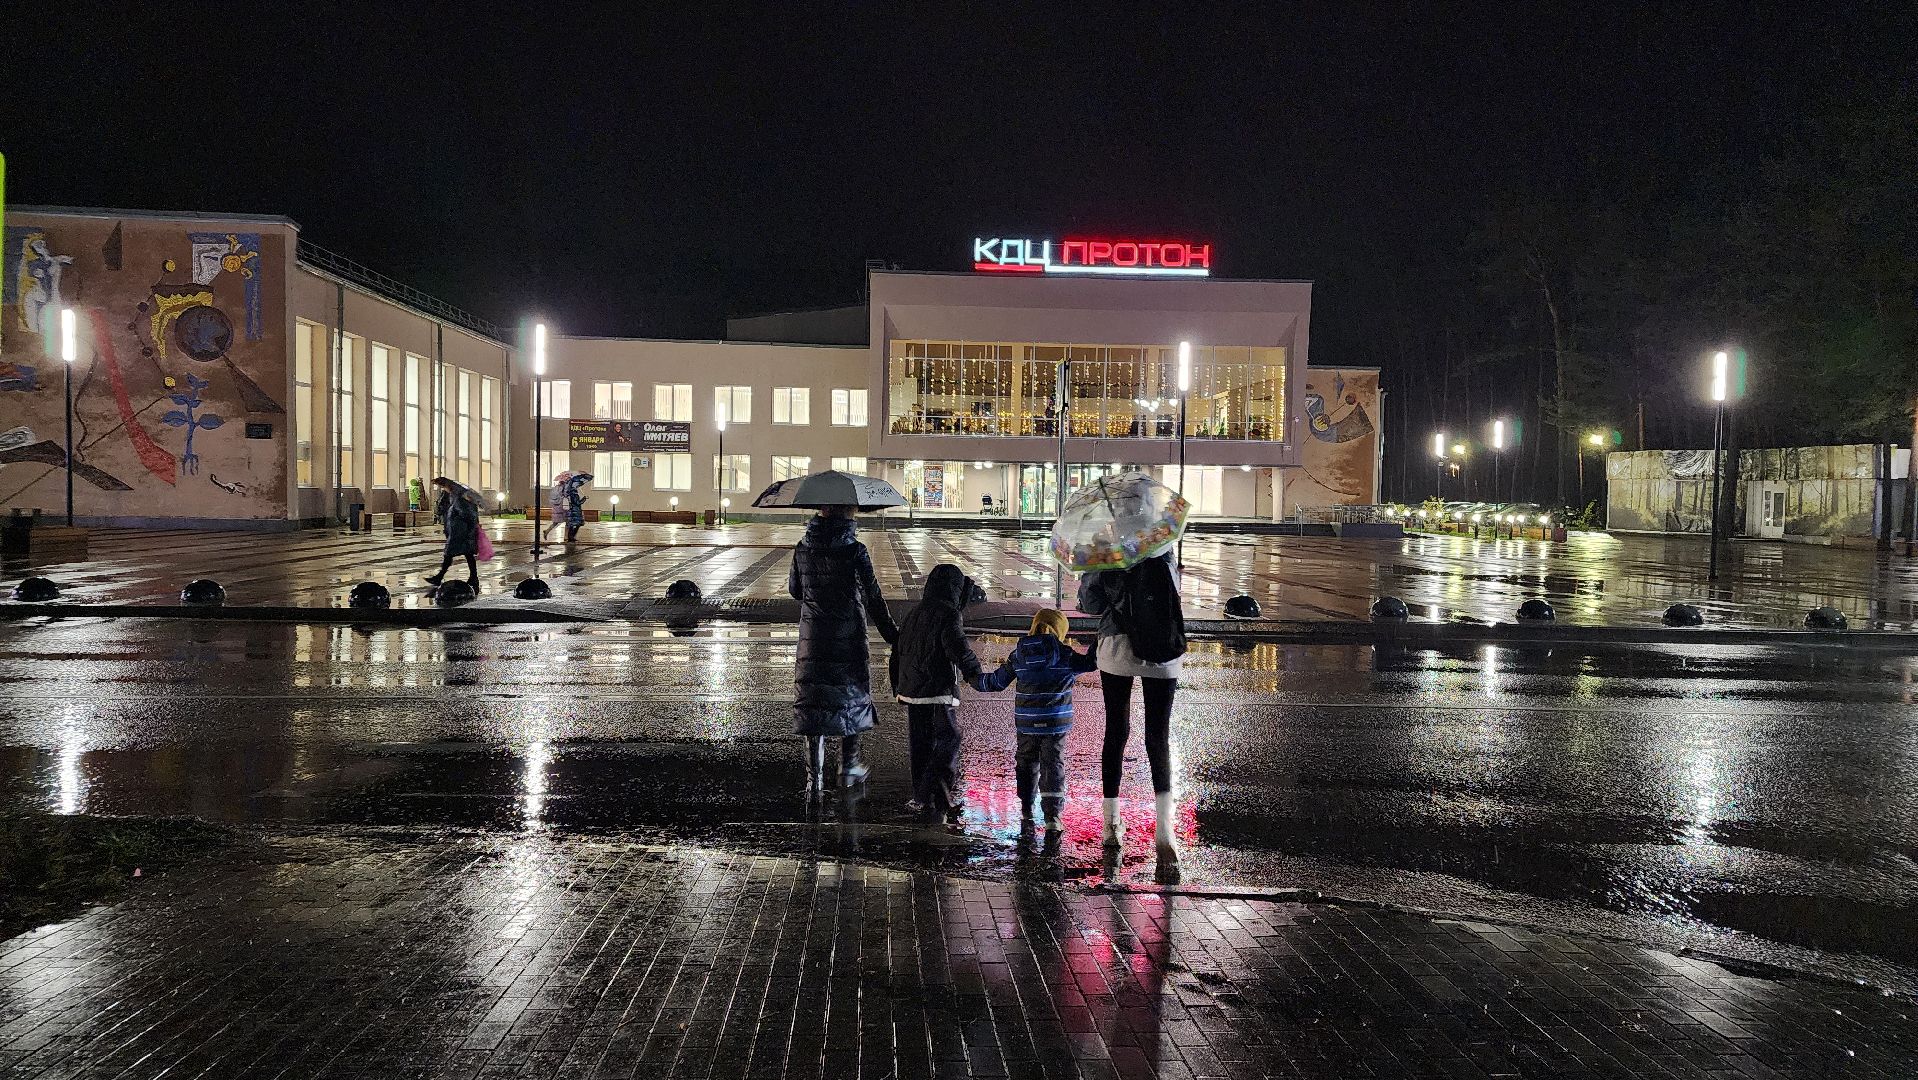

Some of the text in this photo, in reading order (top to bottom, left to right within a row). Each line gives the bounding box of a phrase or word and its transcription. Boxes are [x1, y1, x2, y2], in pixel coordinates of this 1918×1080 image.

[974, 237, 1210, 268] КДЦ ПРОТОН
[643, 423, 667, 432] Олег
[571, 436, 579, 448] 6
[643, 432, 689, 442] МИТЯЕВ
